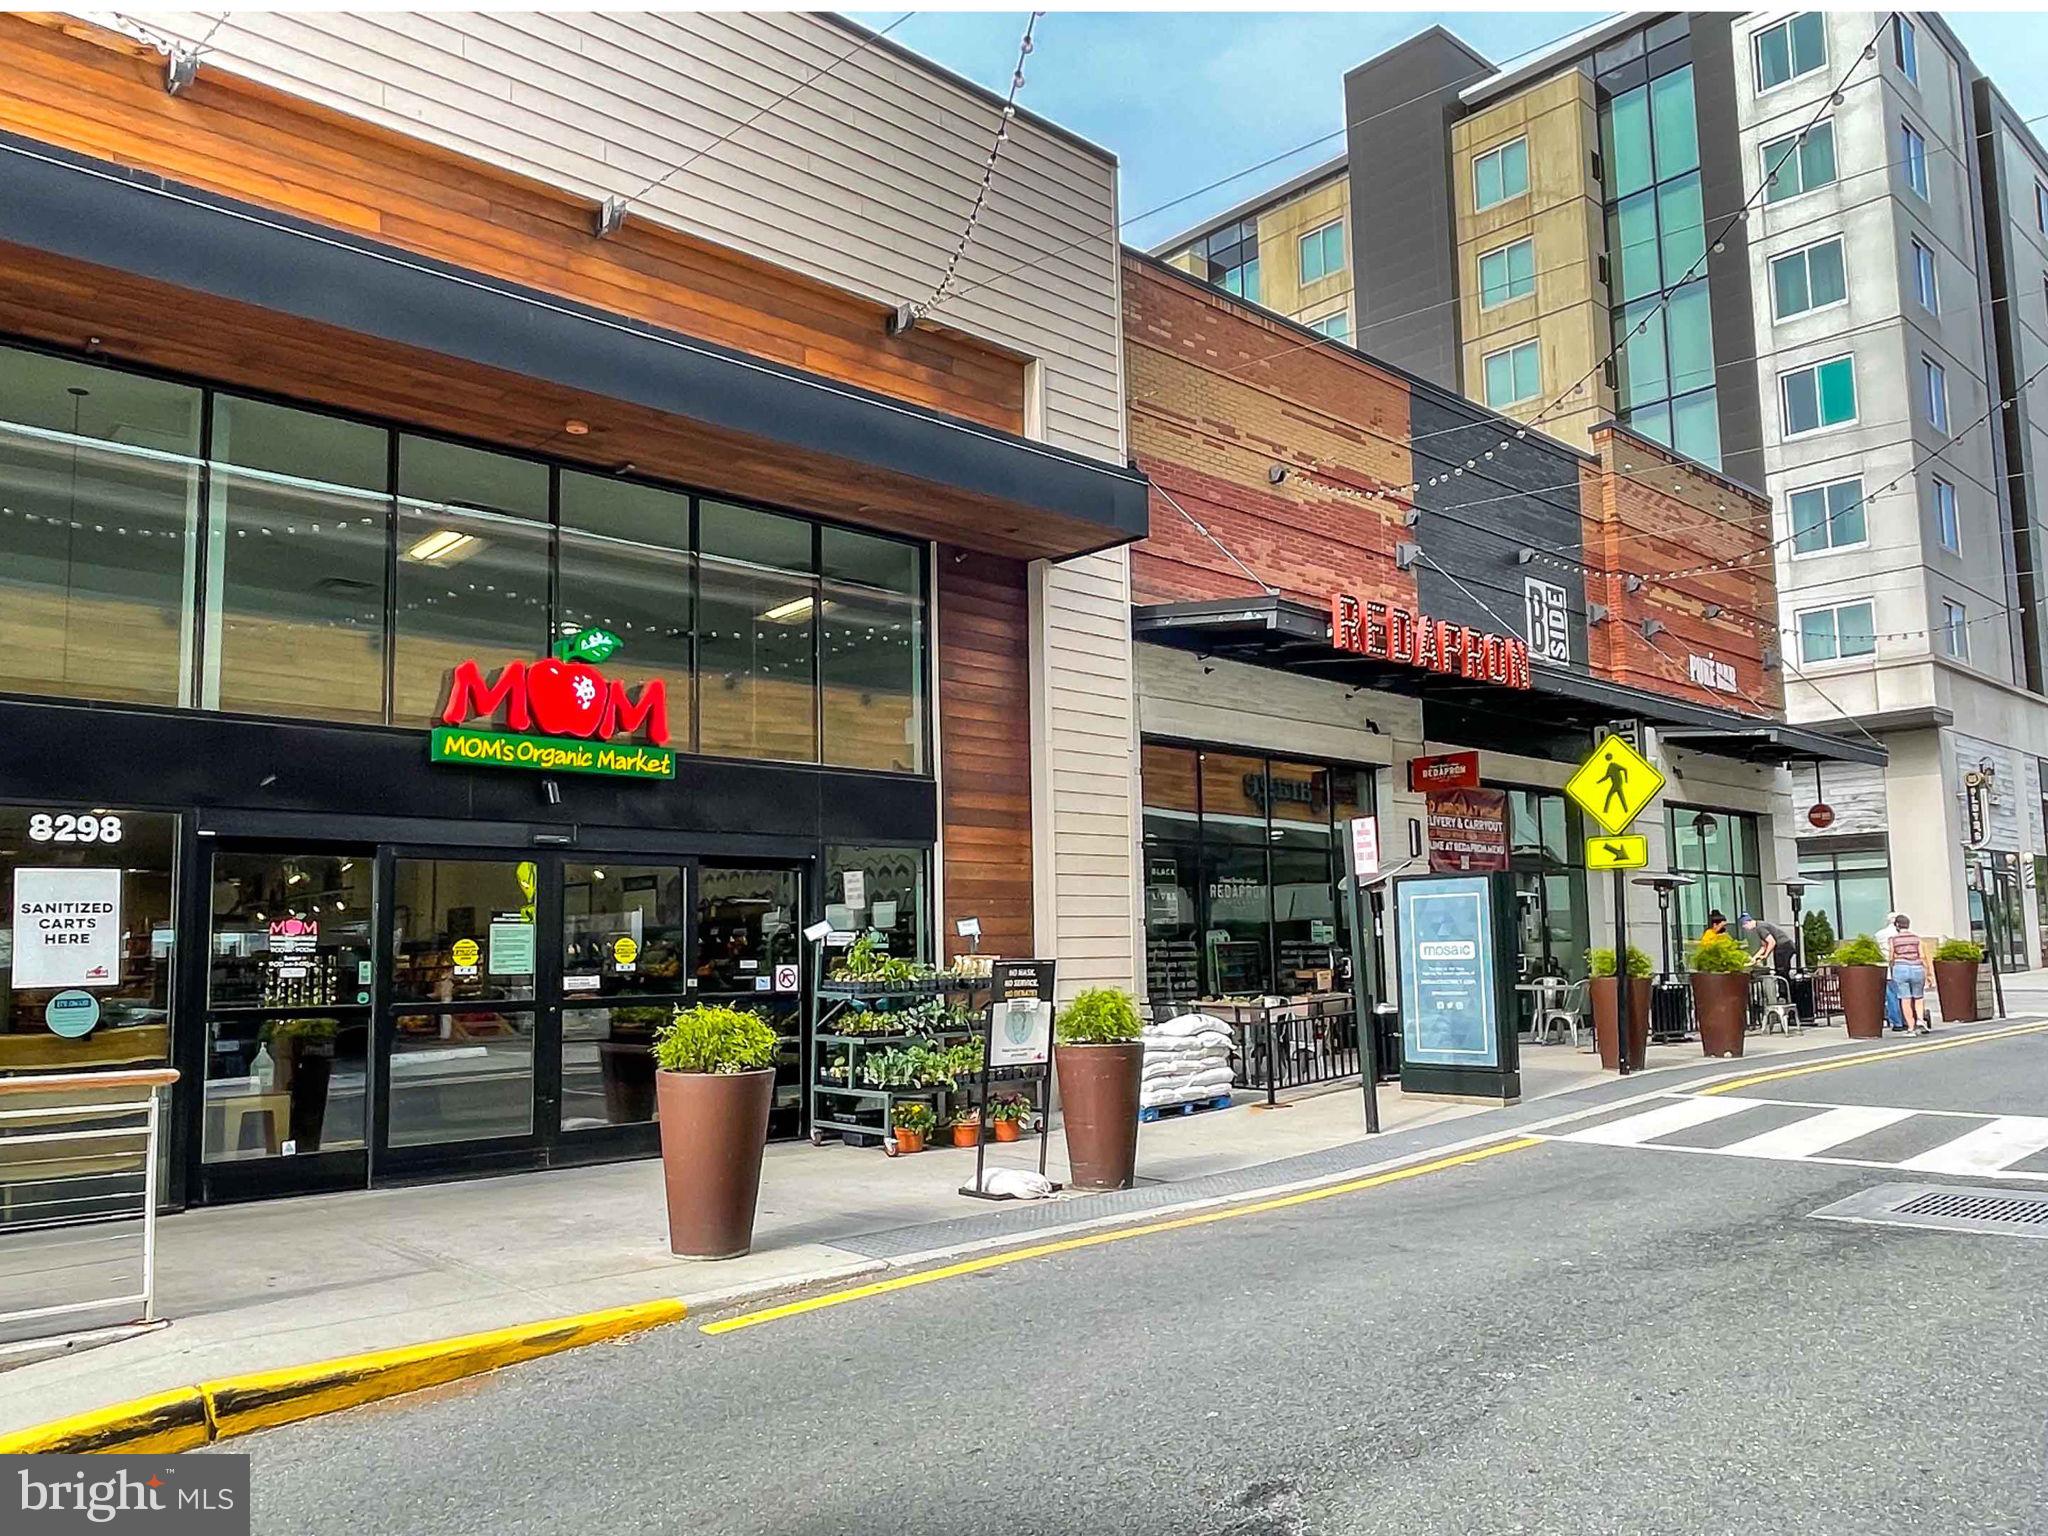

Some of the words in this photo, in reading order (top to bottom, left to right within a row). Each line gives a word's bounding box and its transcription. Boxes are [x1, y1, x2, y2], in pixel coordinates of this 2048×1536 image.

[1549, 589, 1567, 661] SIDE
[1331, 592, 1530, 690] REDAPRON
[442, 656, 672, 745] MOM
[443, 735, 514, 762] MOM's
[517, 741, 593, 767] Organic
[597, 748, 671, 775] Market
[29, 813, 122, 843] 8298
[21, 902, 113, 914] SANITIZED
[38, 918, 96, 930] CARTS
[44, 934, 90, 945] HERE
[1423, 944, 1471, 956] mosaic
